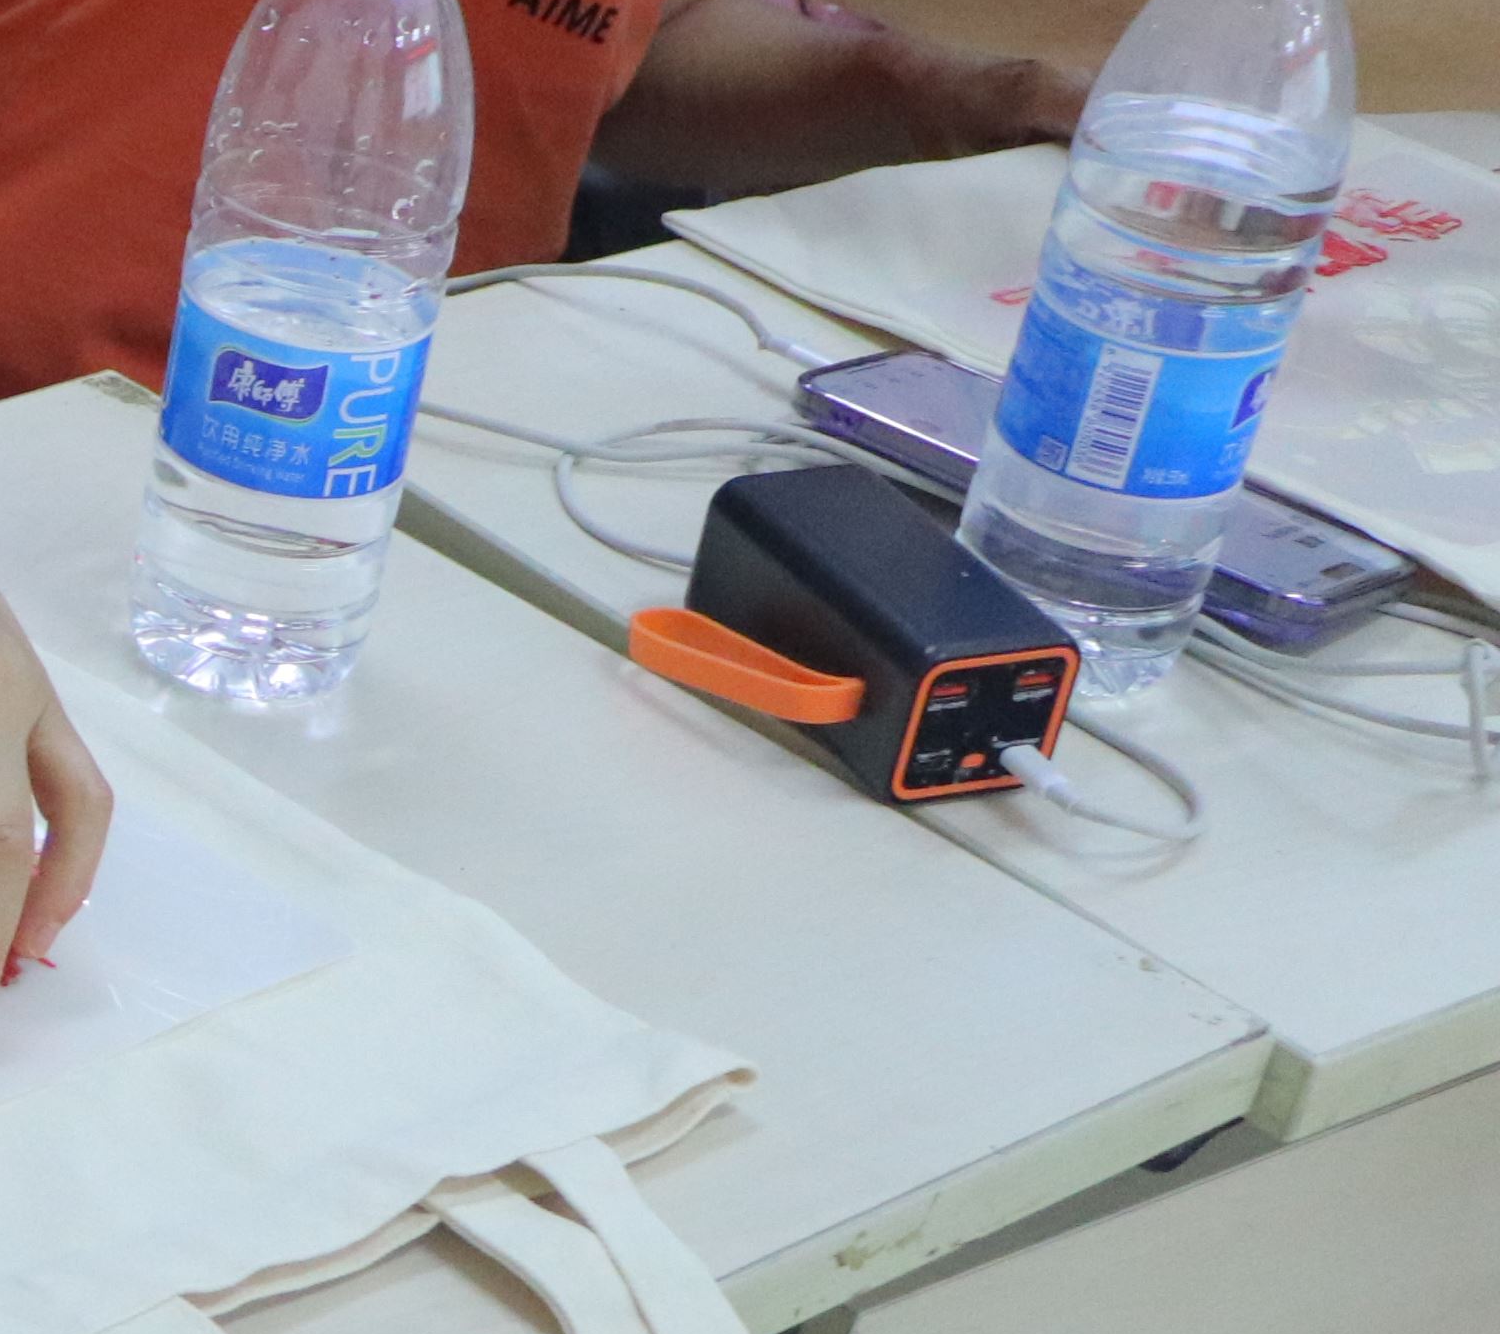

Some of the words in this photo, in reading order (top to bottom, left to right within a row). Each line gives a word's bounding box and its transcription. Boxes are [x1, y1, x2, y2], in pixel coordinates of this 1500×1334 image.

[201, 415, 312, 467] 饮用纯净水
[321, 351, 400, 498] PURE
